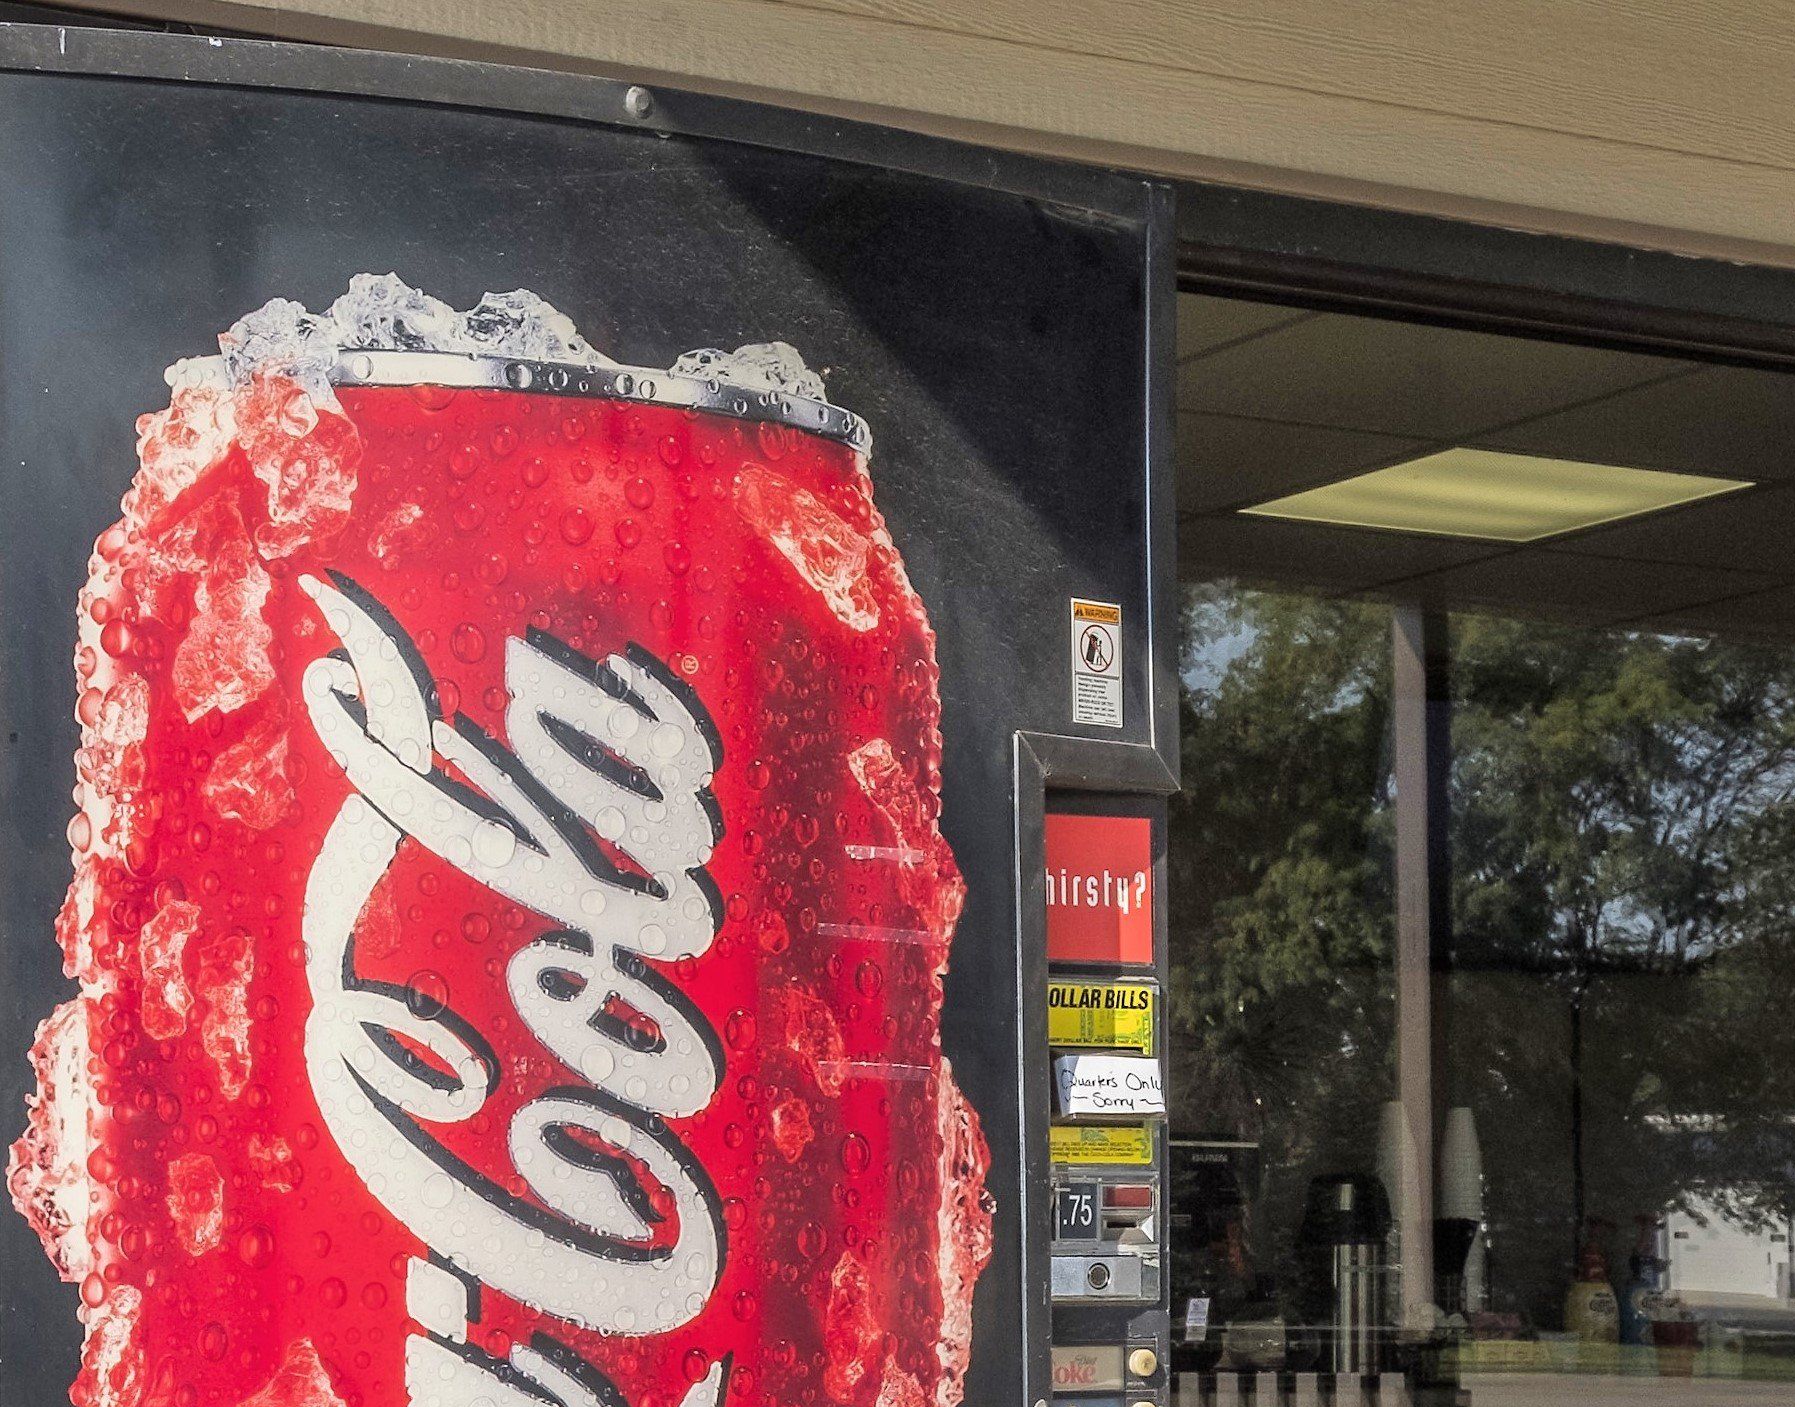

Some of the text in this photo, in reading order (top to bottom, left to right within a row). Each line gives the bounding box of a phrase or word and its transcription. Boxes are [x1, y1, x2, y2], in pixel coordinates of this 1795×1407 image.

[1046, 868, 1146, 915] hirsty?
[1049, 988, 1149, 1010] OLLAR BILLS
[1126, 1073, 1163, 1098] Only
[1092, 1092, 1134, 1110] Sorry
[1063, 1195, 1092, 1226] .75
[1053, 1361, 1097, 1384] oke
